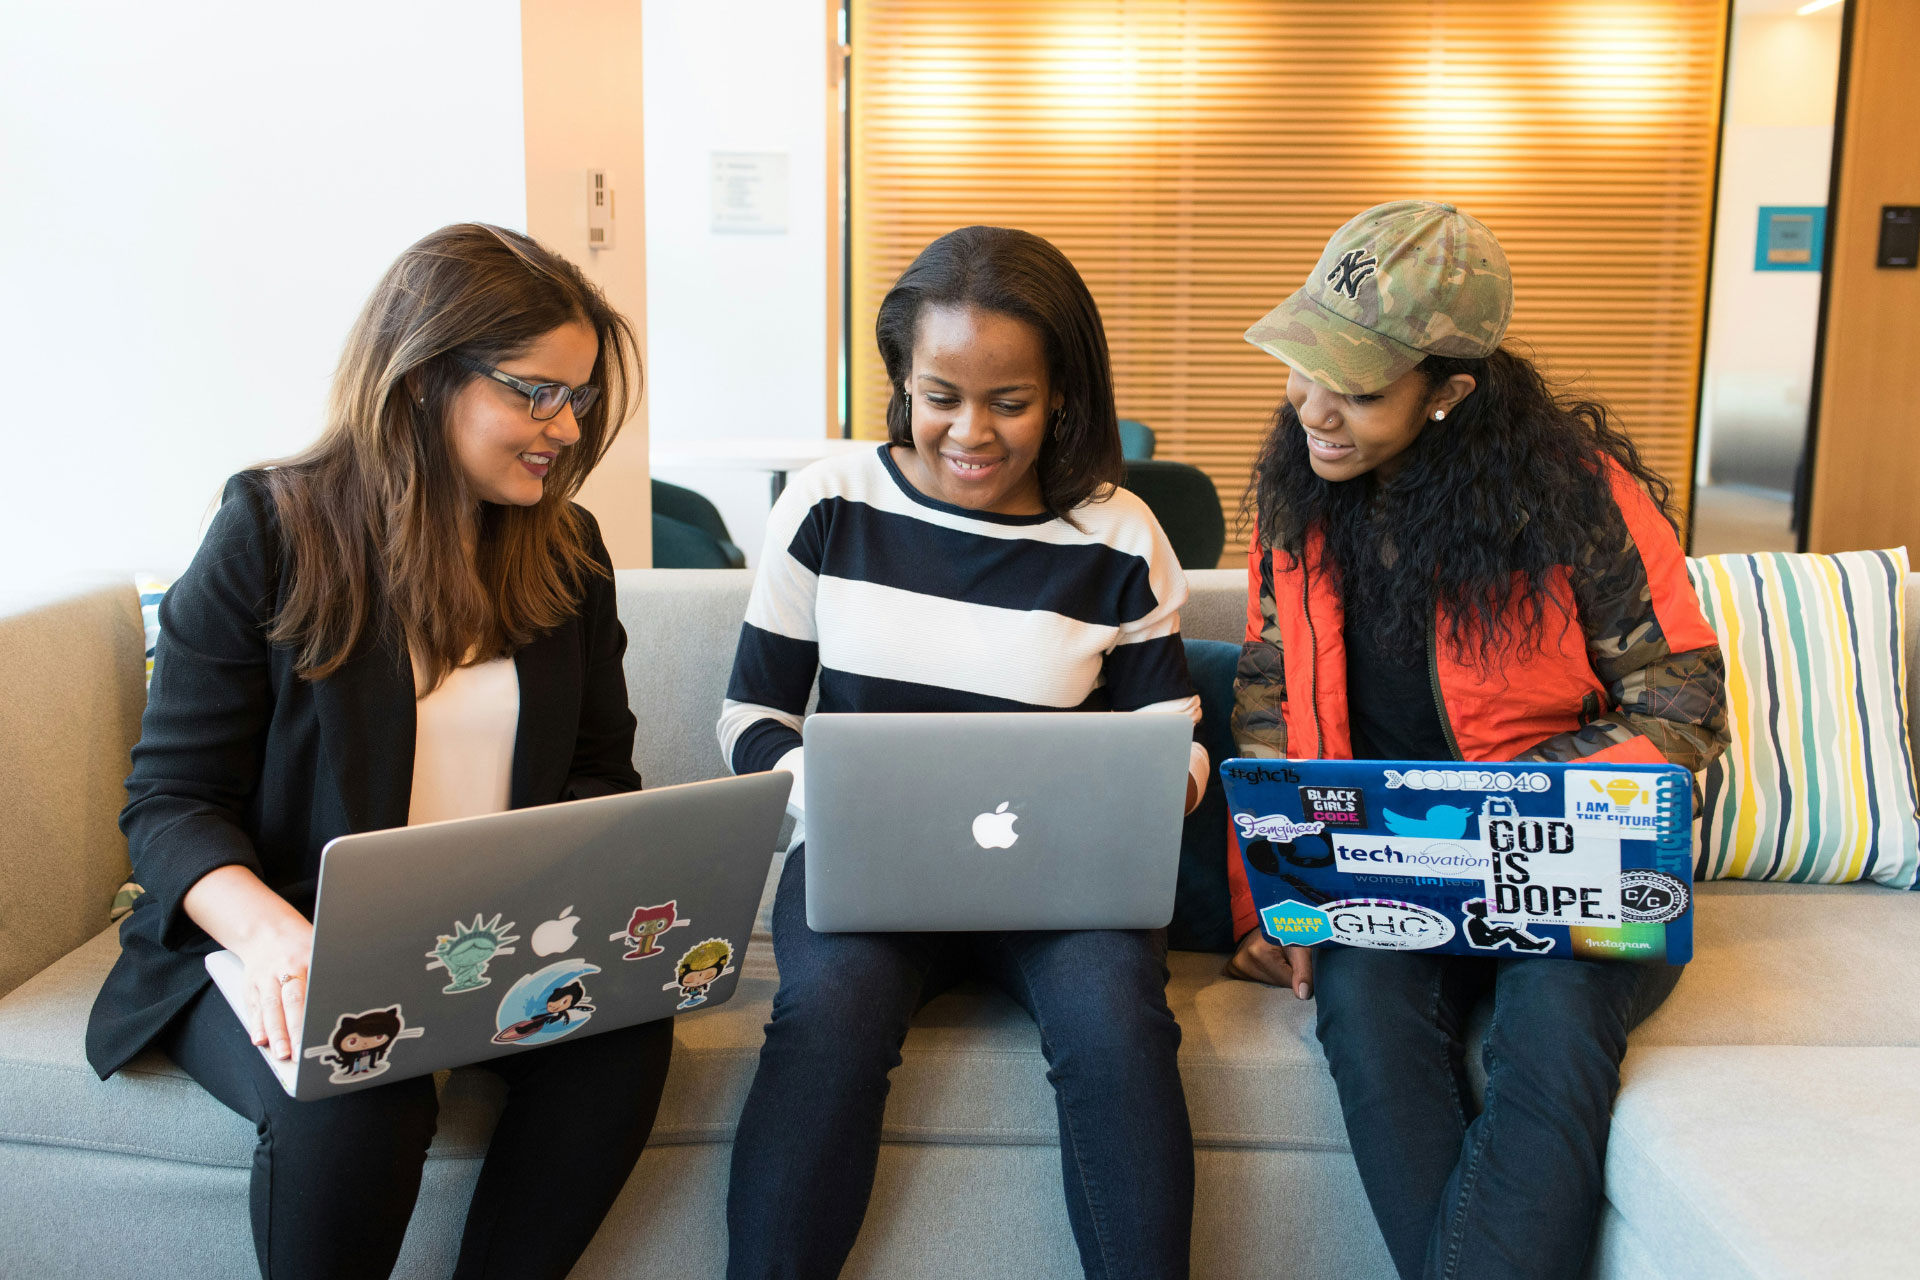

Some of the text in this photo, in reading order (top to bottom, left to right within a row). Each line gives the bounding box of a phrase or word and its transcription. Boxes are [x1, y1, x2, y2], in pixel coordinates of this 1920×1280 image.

[1404, 771, 1549, 791] CODE2040
[1307, 789, 1357, 801] BLACK
[1313, 800, 1356, 812] GIRLS
[1576, 801, 1609, 813] I AM
[1313, 811, 1360, 822] CODE
[1237, 815, 1322, 841] Femgineer
[1489, 820, 1575, 854] GOD
[1492, 851, 1530, 884] IS
[1495, 883, 1616, 919] DOPE.
[1273, 917, 1323, 926] MAKER
[1333, 914, 1429, 936] GHC
[1276, 924, 1319, 933] PARTY
[1585, 938, 1651, 951] Instagram
